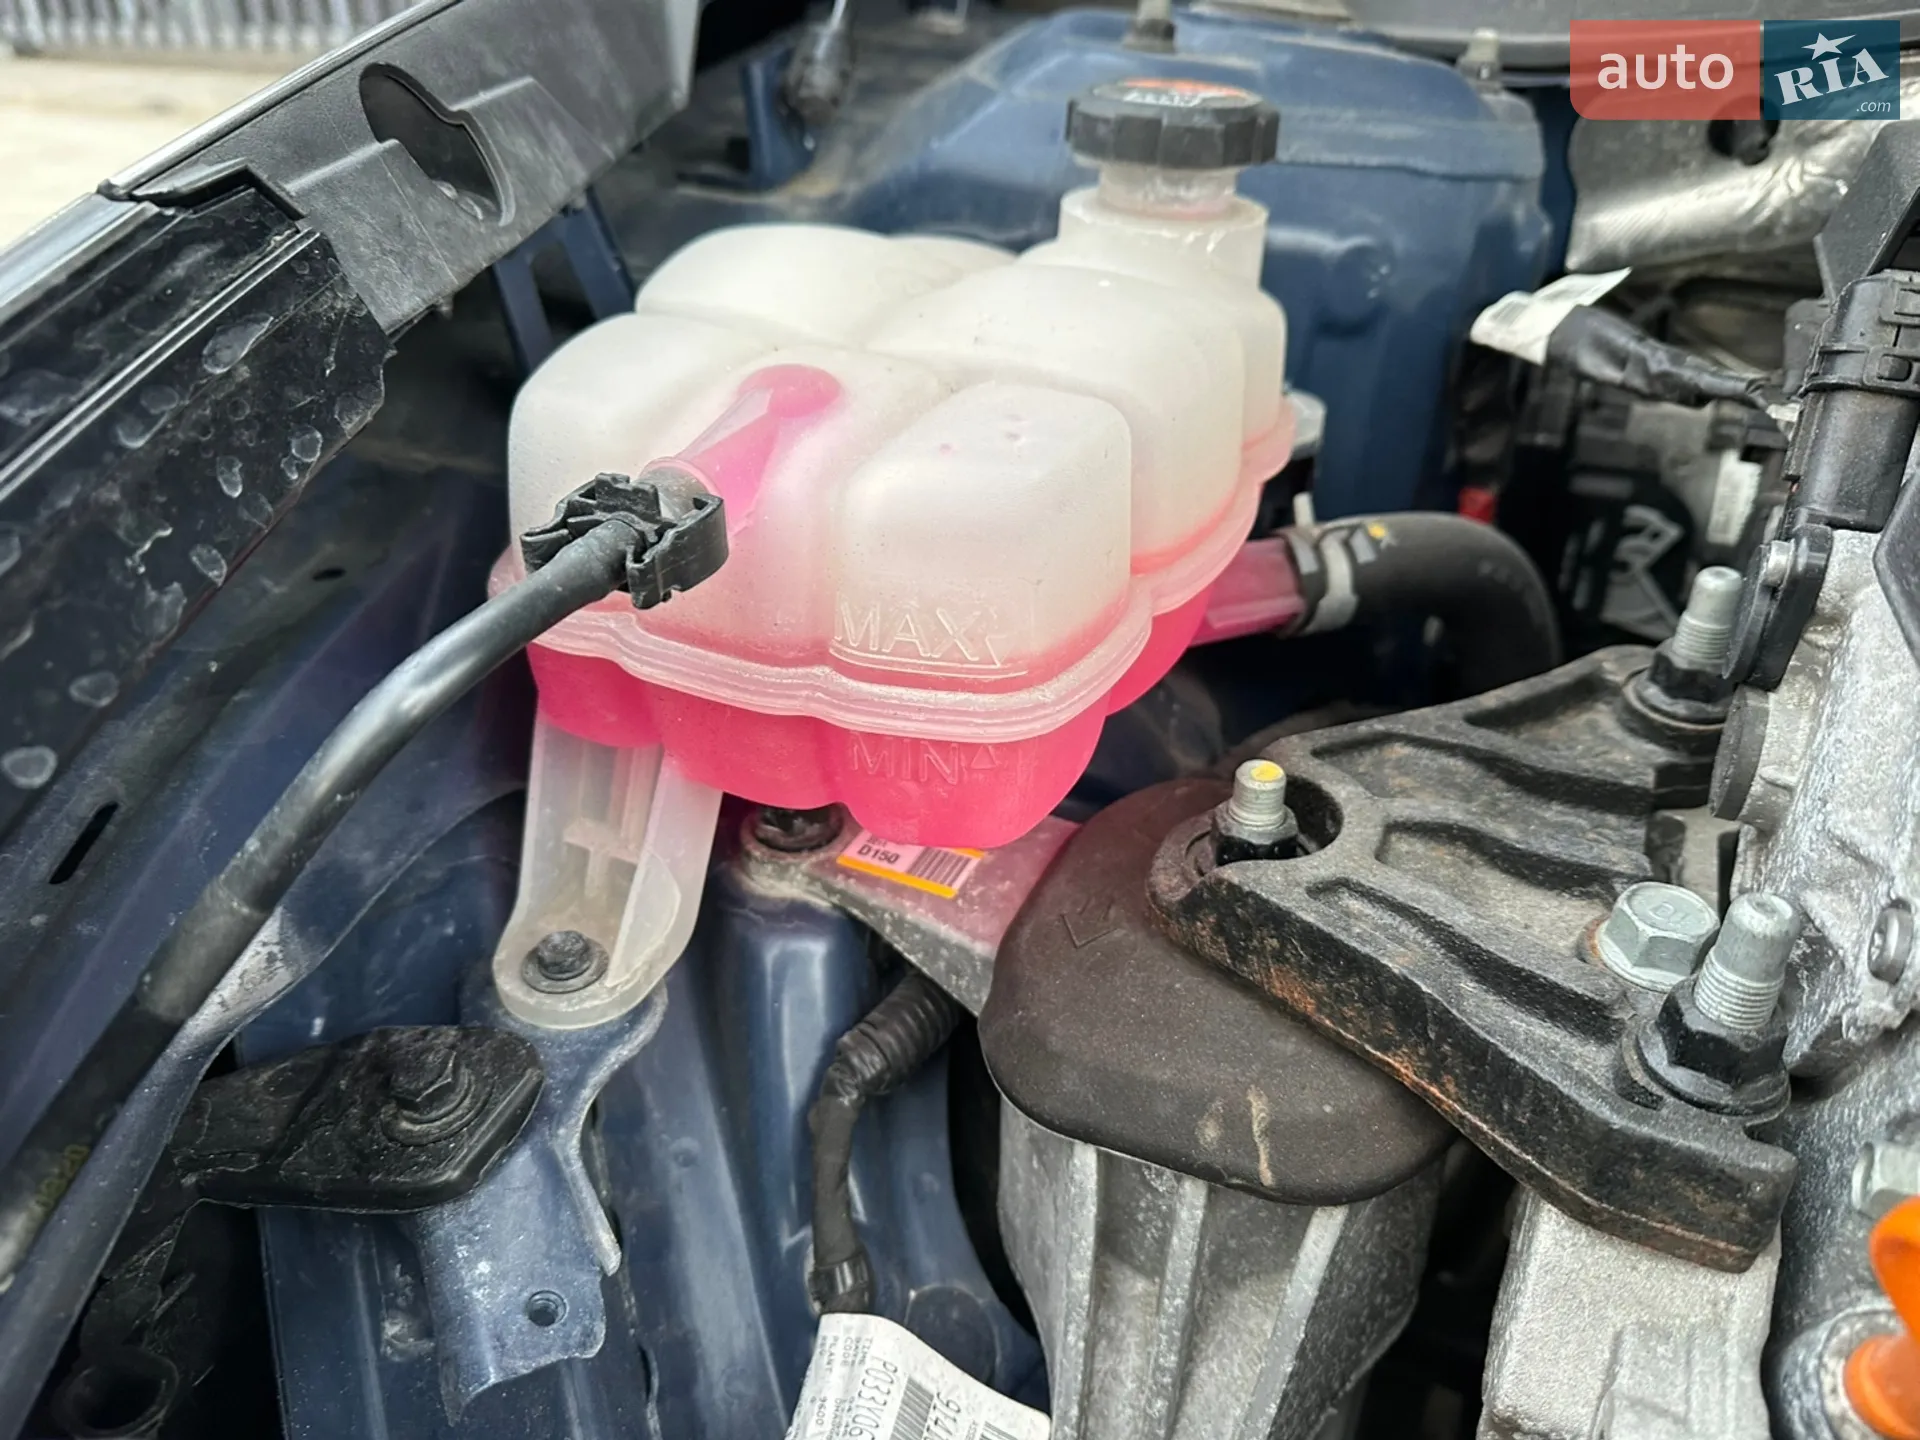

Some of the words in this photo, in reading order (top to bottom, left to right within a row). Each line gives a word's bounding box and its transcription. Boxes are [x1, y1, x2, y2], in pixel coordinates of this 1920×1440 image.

[833, 602, 980, 661] MAX
[850, 732, 959, 785] MIN
[857, 844, 900, 864] D150
[825, 1335, 839, 1374] PLANT
